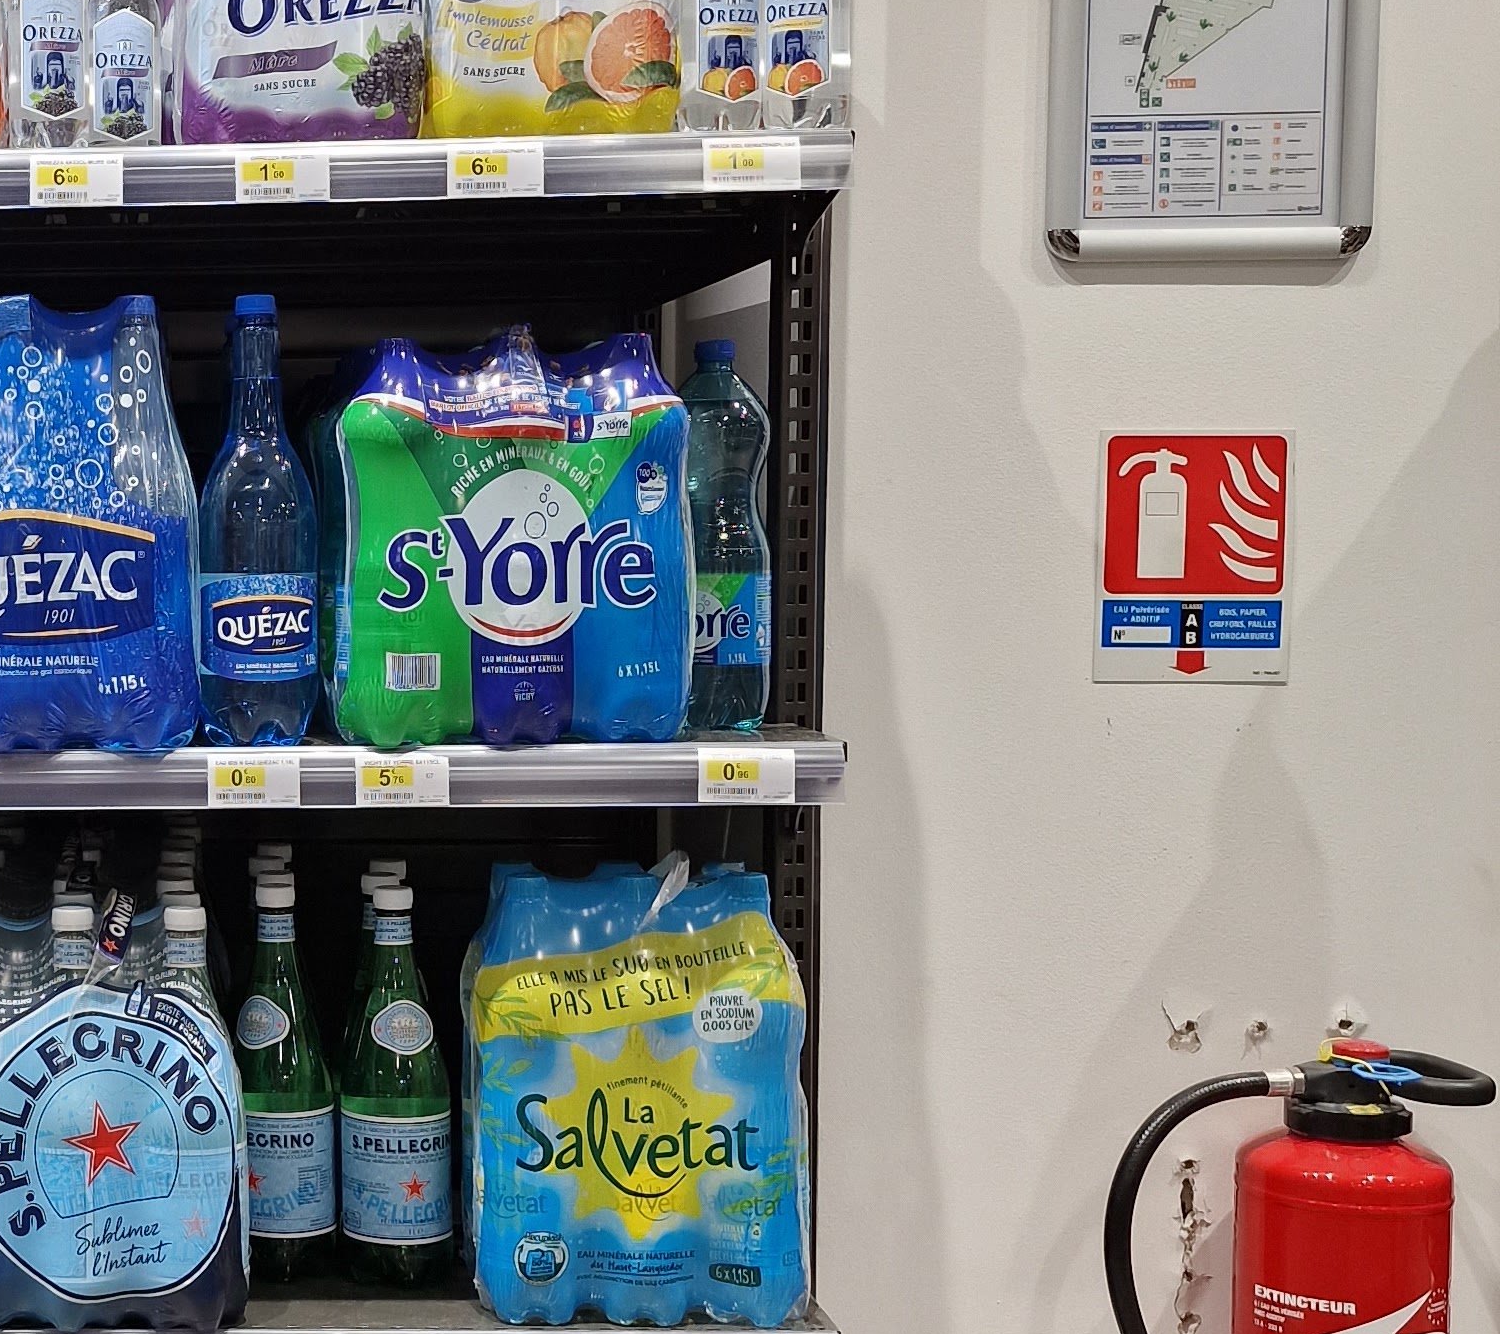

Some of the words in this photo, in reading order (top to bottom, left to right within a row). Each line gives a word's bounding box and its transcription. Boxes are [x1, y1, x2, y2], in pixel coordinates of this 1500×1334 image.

[767, 3, 828, 23] OREZZA
[22, 25, 83, 42] OREZZA
[466, 29, 531, 52] Cédrat
[95, 52, 152, 69] OREZZA
[250, 55, 298, 72] Mûre
[463, 67, 491, 78] SANS
[493, 67, 525, 77] SUCRE
[253, 82, 278, 92] SANS
[281, 78, 317, 90] SUCRE
[450, 468, 480, 499] RICHE
[479, 455, 495, 473] EN
[496, 443, 547, 466] MINÉRAUX
[556, 460, 570, 474] EN
[44, 609, 75, 624] 1901
[1113, 606, 1129, 614] EAU
[217, 606, 310, 646] QUÉZAC
[1185, 614, 1198, 627] A
[1185, 631, 1197, 645] B
[517, 971, 547, 990] ELLE
[564, 968, 587, 983] MIS
[593, 967, 607, 982] LE
[612, 955, 649, 978] SUD
[655, 956, 670, 970] EN
[550, 988, 592, 1017] PAS
[601, 984, 630, 1011] LE
[639, 976, 679, 1005] SEL
[710, 995, 744, 1007] PAUVRE
[701, 1009, 713, 1020] EN
[716, 1007, 755, 1020] SODIUM
[606, 1075, 648, 1091] finement
[650, 1078, 688, 1109] pétillante
[624, 1097, 655, 1124] La
[515, 1087, 759, 1199] Salvetat
[75, 1216, 161, 1255] Sublimez
[577, 1250, 596, 1259] EAU
[597, 1248, 643, 1260] MINÉRALE
[646, 1249, 695, 1260] NATURELLE
[1254, 1283, 1357, 1316] EXTINCTEUR
